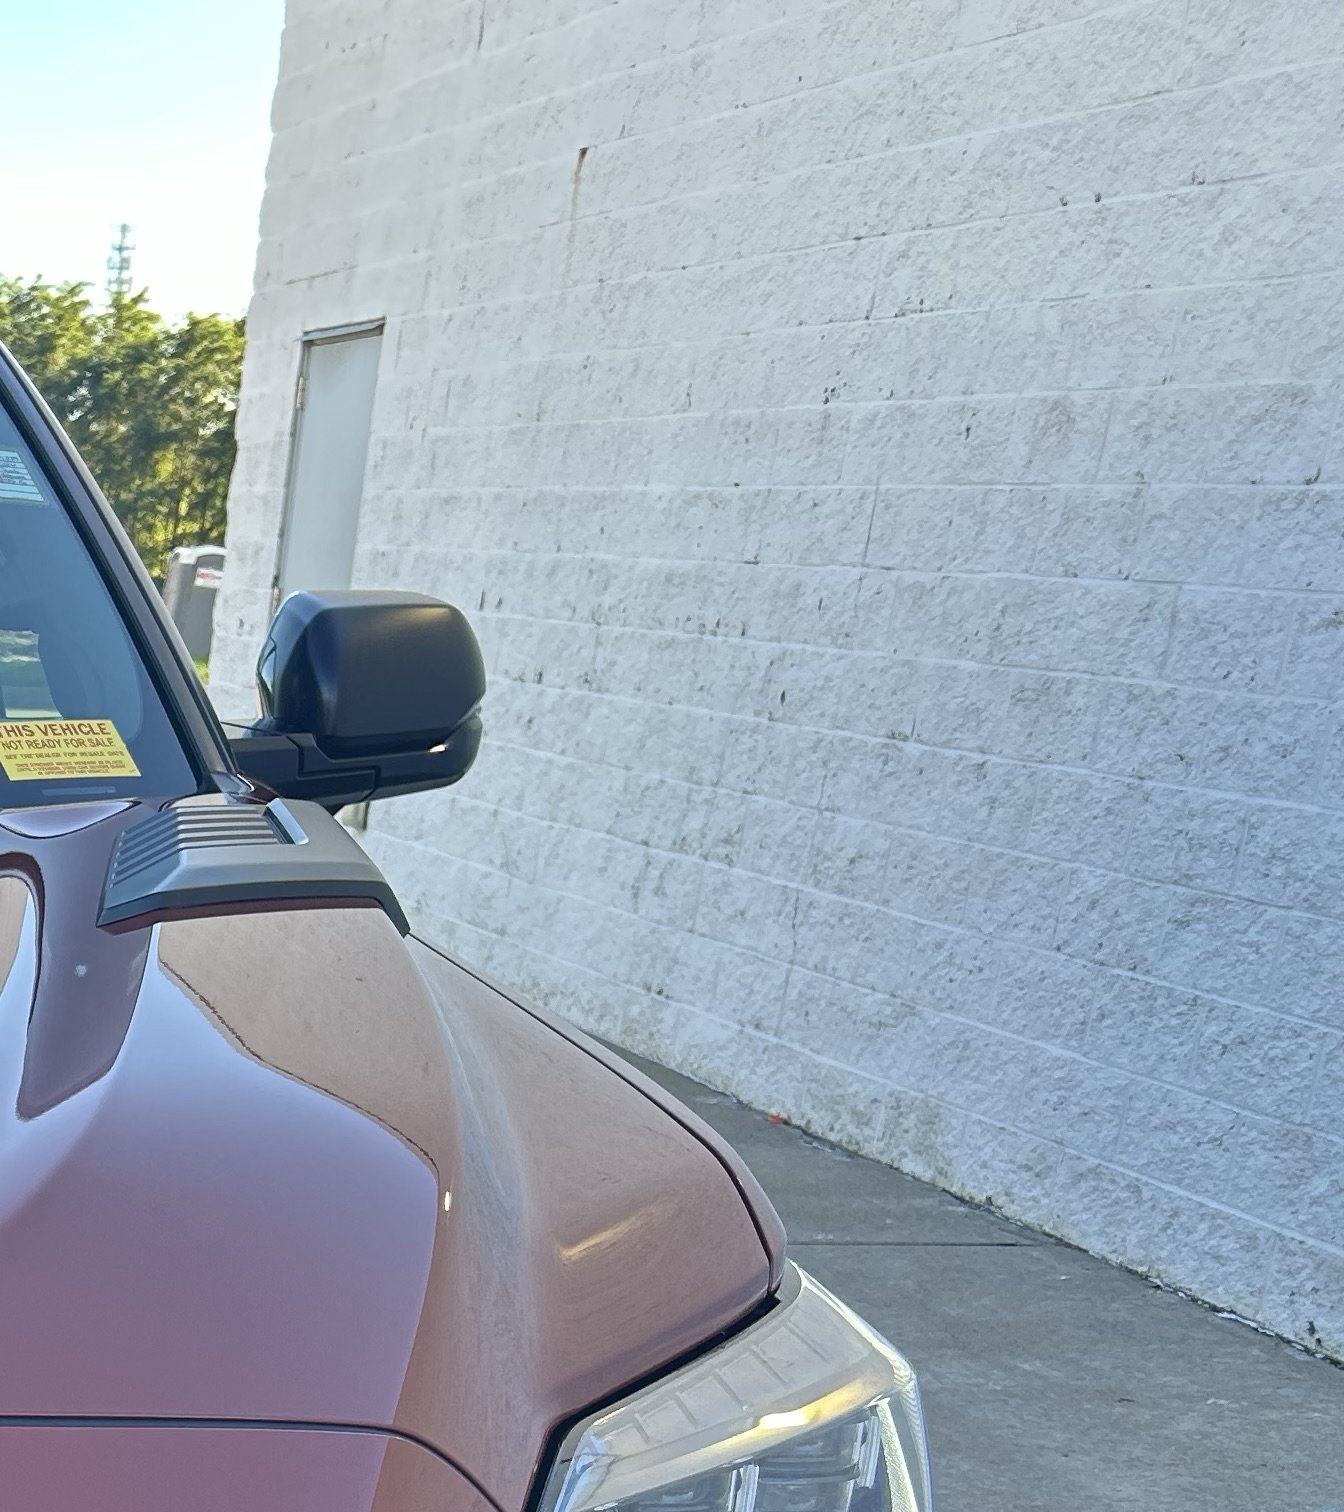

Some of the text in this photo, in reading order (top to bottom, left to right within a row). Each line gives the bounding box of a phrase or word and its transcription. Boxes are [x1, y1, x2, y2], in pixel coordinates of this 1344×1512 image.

[35, 722, 111, 737] VEHICLE
[0, 737, 114, 751] NOT READY FOR SALE
